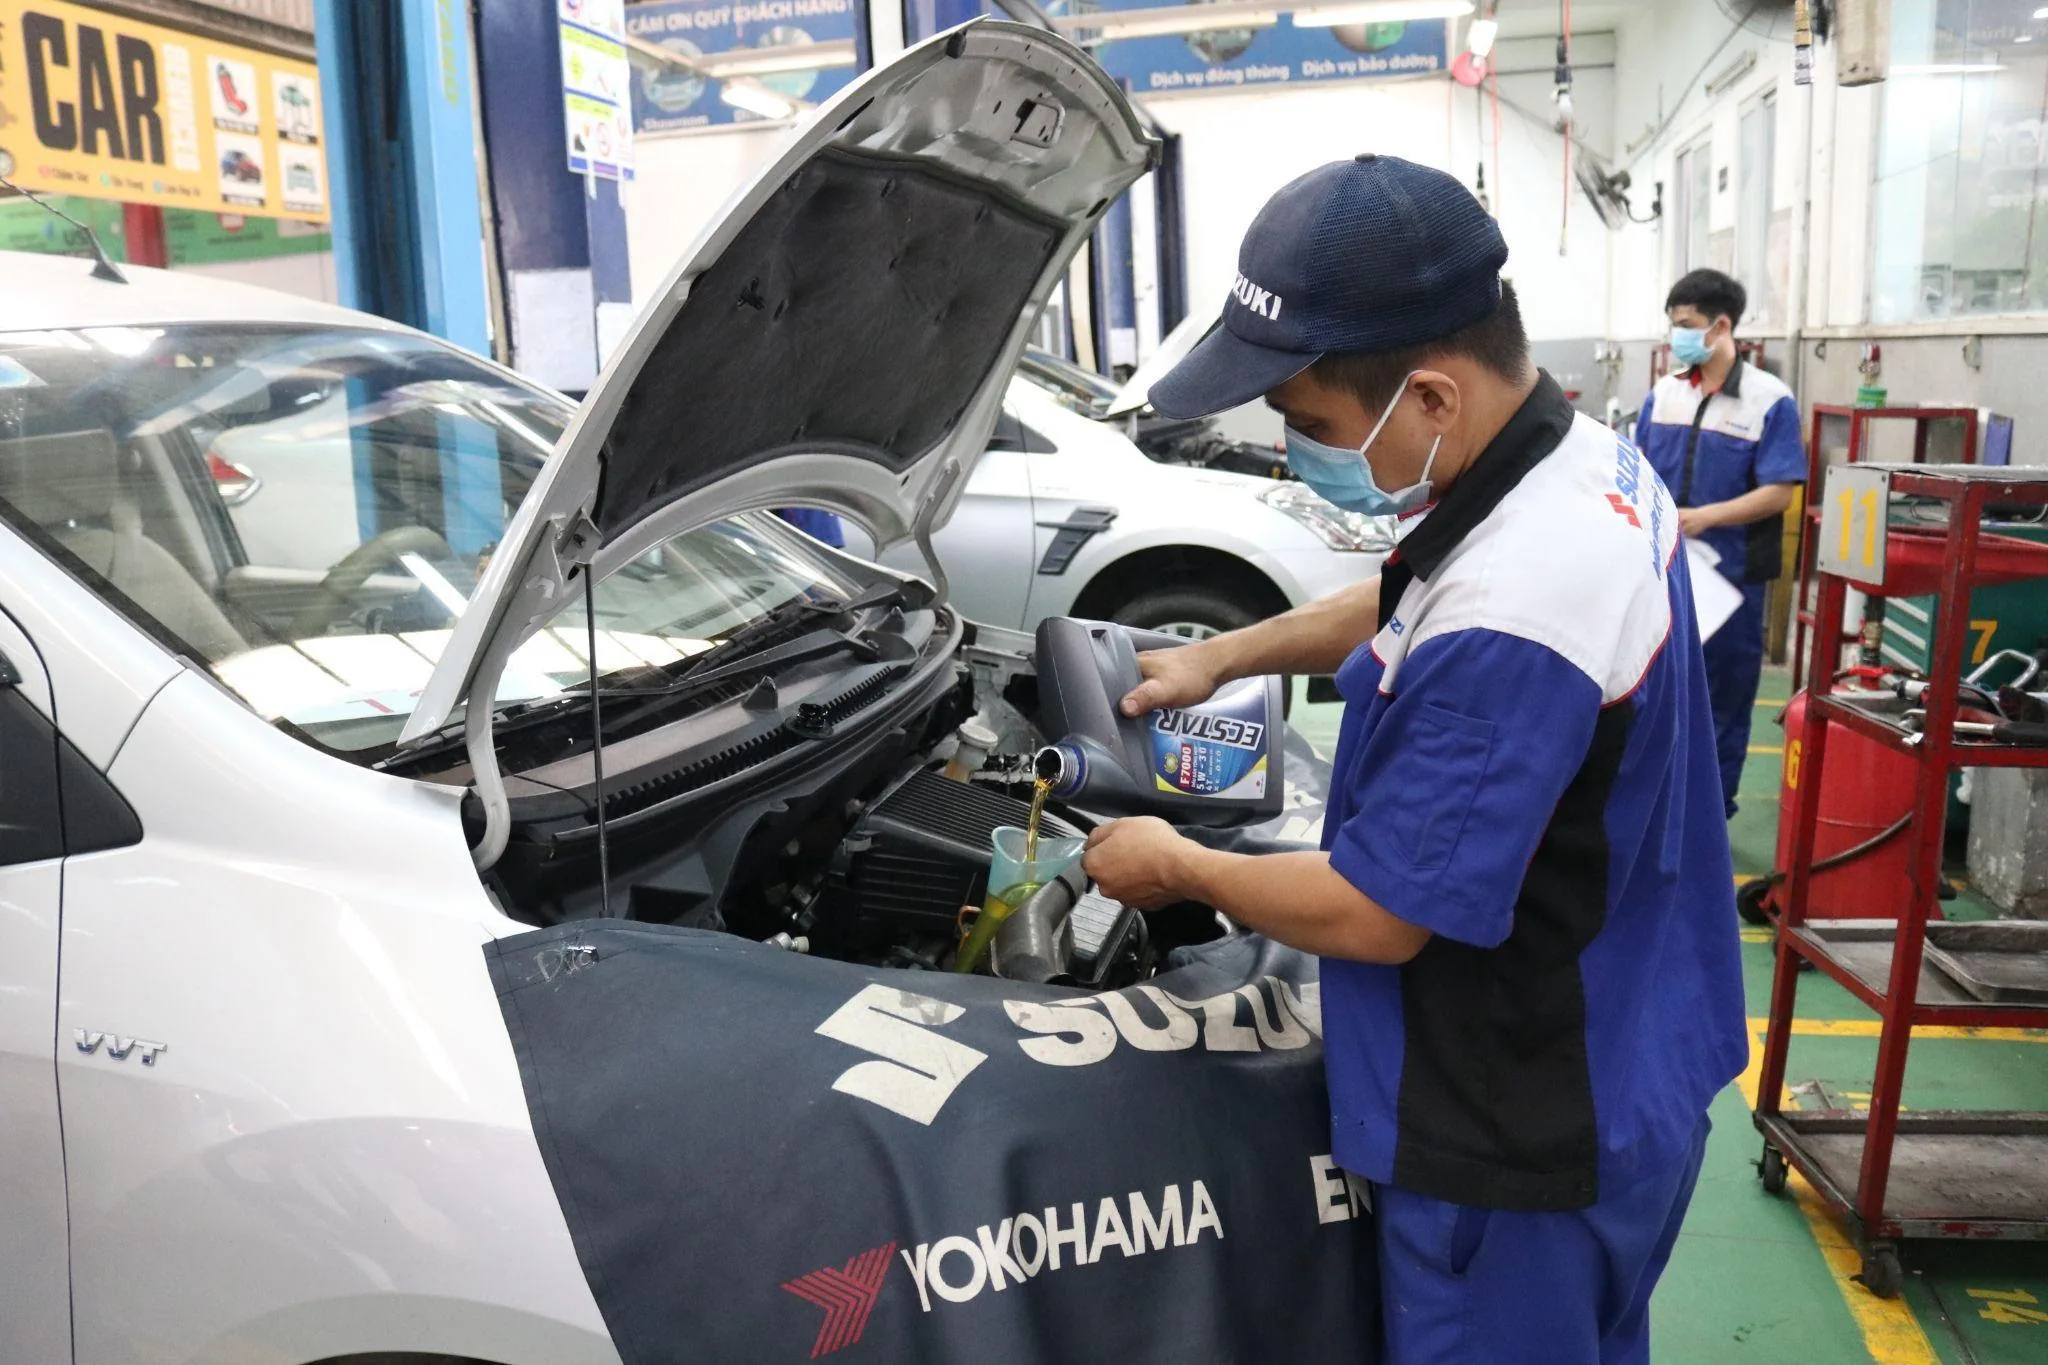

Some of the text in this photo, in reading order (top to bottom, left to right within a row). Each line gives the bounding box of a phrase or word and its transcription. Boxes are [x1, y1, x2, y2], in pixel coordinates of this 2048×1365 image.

[1150, 70, 1184, 88] Dịch
[1184, 72, 1205, 87] vụ
[1302, 60, 1336, 78] Dịch
[1337, 61, 1357, 76] vụ
[1358, 55, 1388, 72] bảo
[21, 11, 166, 166] CAR
[1838, 487, 1878, 569] 11
[1970, 619, 1999, 665] 7
[1156, 708, 1262, 748] ECSTAR
[1179, 746, 1192, 785] F7000
[73, 1028, 167, 1066] VVT
[900, 1180, 1224, 1312] YOKOHAMA
